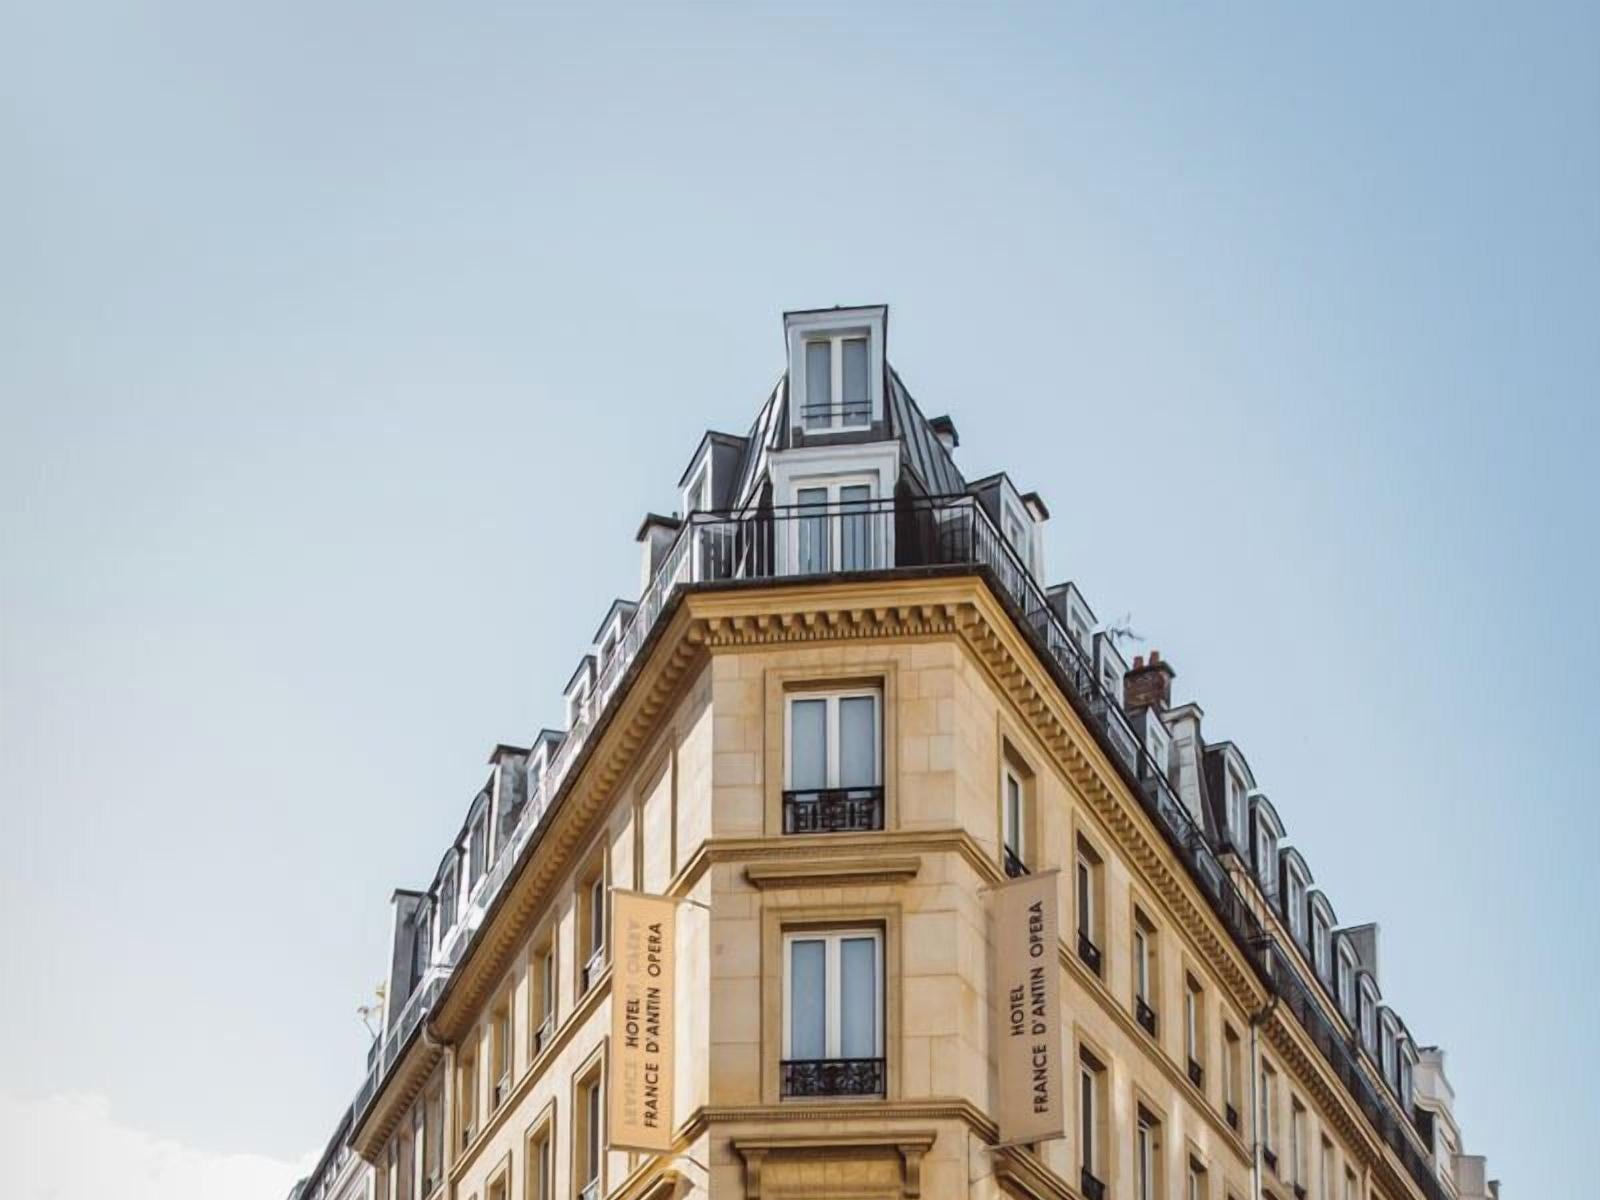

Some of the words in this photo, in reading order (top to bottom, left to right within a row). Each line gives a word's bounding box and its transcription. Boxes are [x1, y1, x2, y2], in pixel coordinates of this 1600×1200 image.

[647, 923, 662, 977] OPERA
[1028, 900, 1044, 958] OPERA
[625, 998, 640, 1048] HOTEL
[645, 987, 660, 1053] D'ANTIN
[1010, 983, 1025, 1036] HOTEL
[1030, 967, 1047, 1035] D'ANTIN
[644, 1063, 659, 1128] FRANCE
[1032, 1044, 1049, 1114] FRANCE
